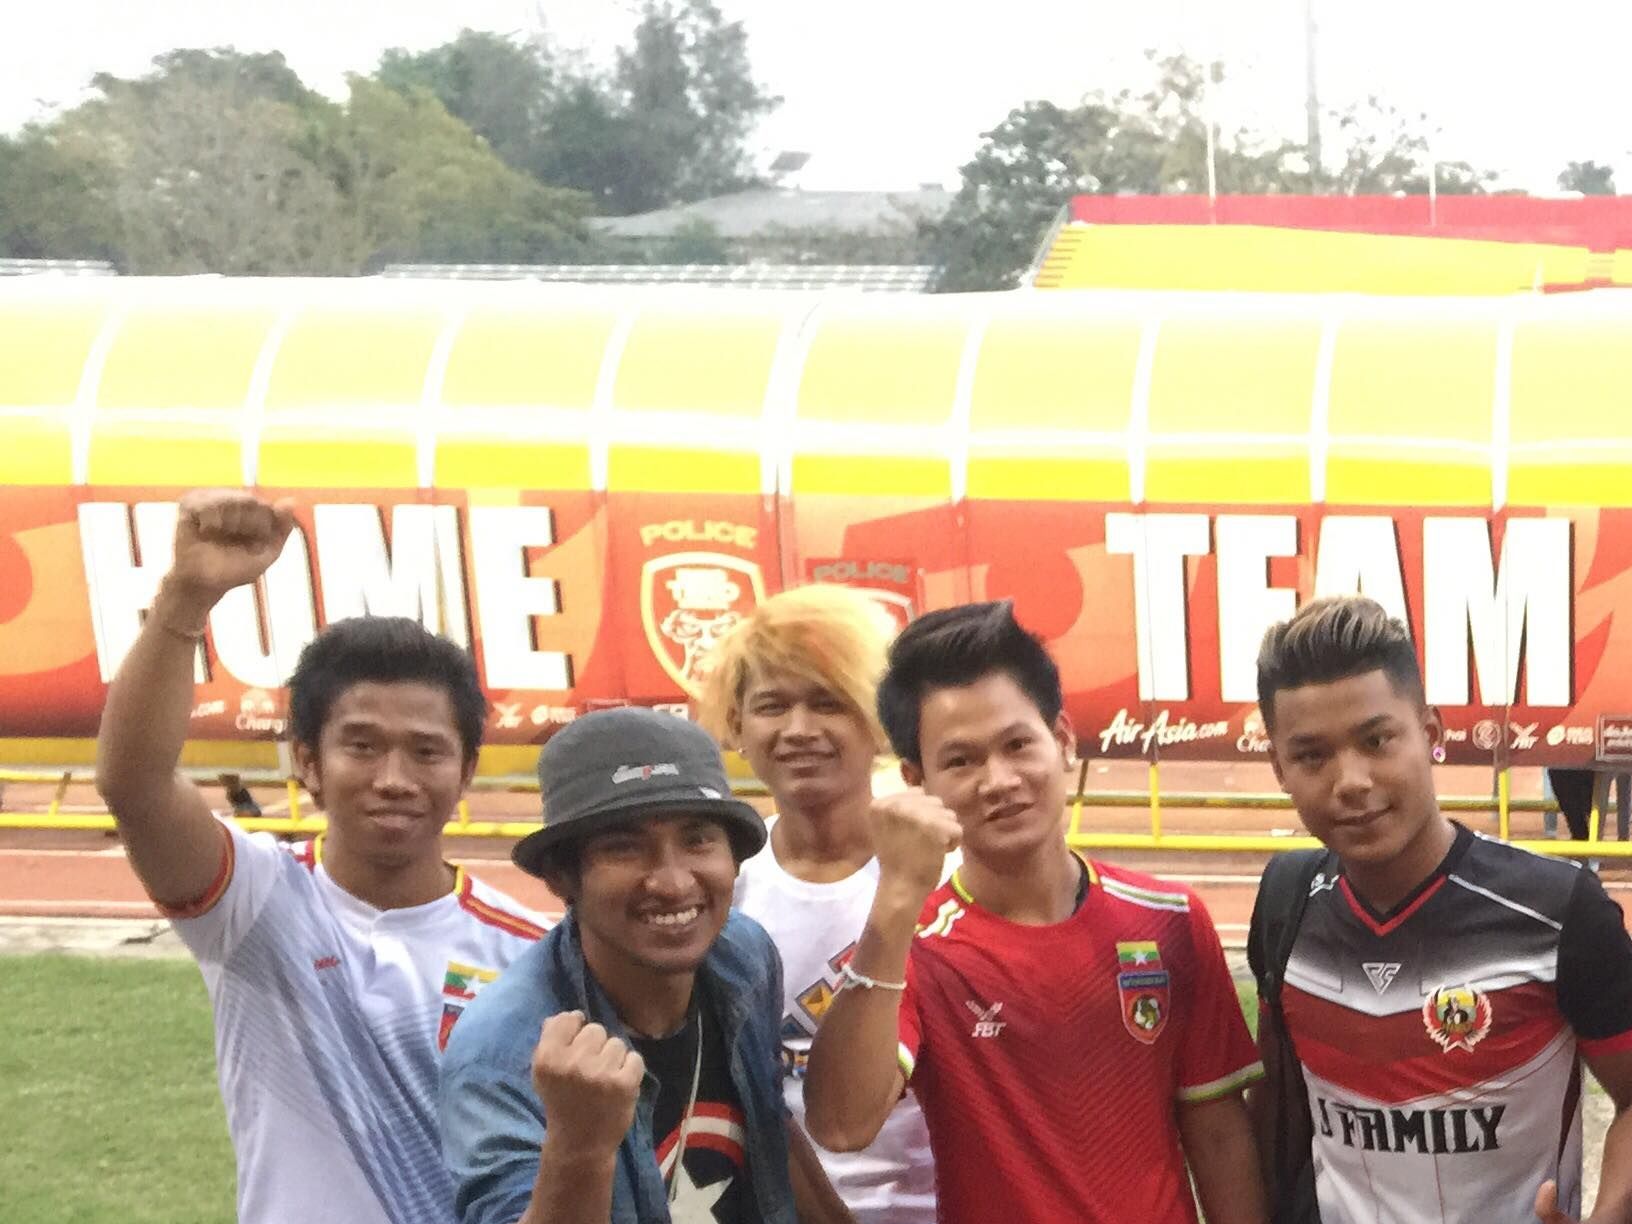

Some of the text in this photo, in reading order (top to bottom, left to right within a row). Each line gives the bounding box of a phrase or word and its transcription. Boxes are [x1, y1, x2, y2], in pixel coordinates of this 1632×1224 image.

[640, 521, 757, 548] POLICE
[78, 500, 574, 690] HOME
[813, 561, 908, 582] POLICE
[1104, 512, 1574, 706] TEAM
[1331, 1103, 1506, 1154] FAMILY
